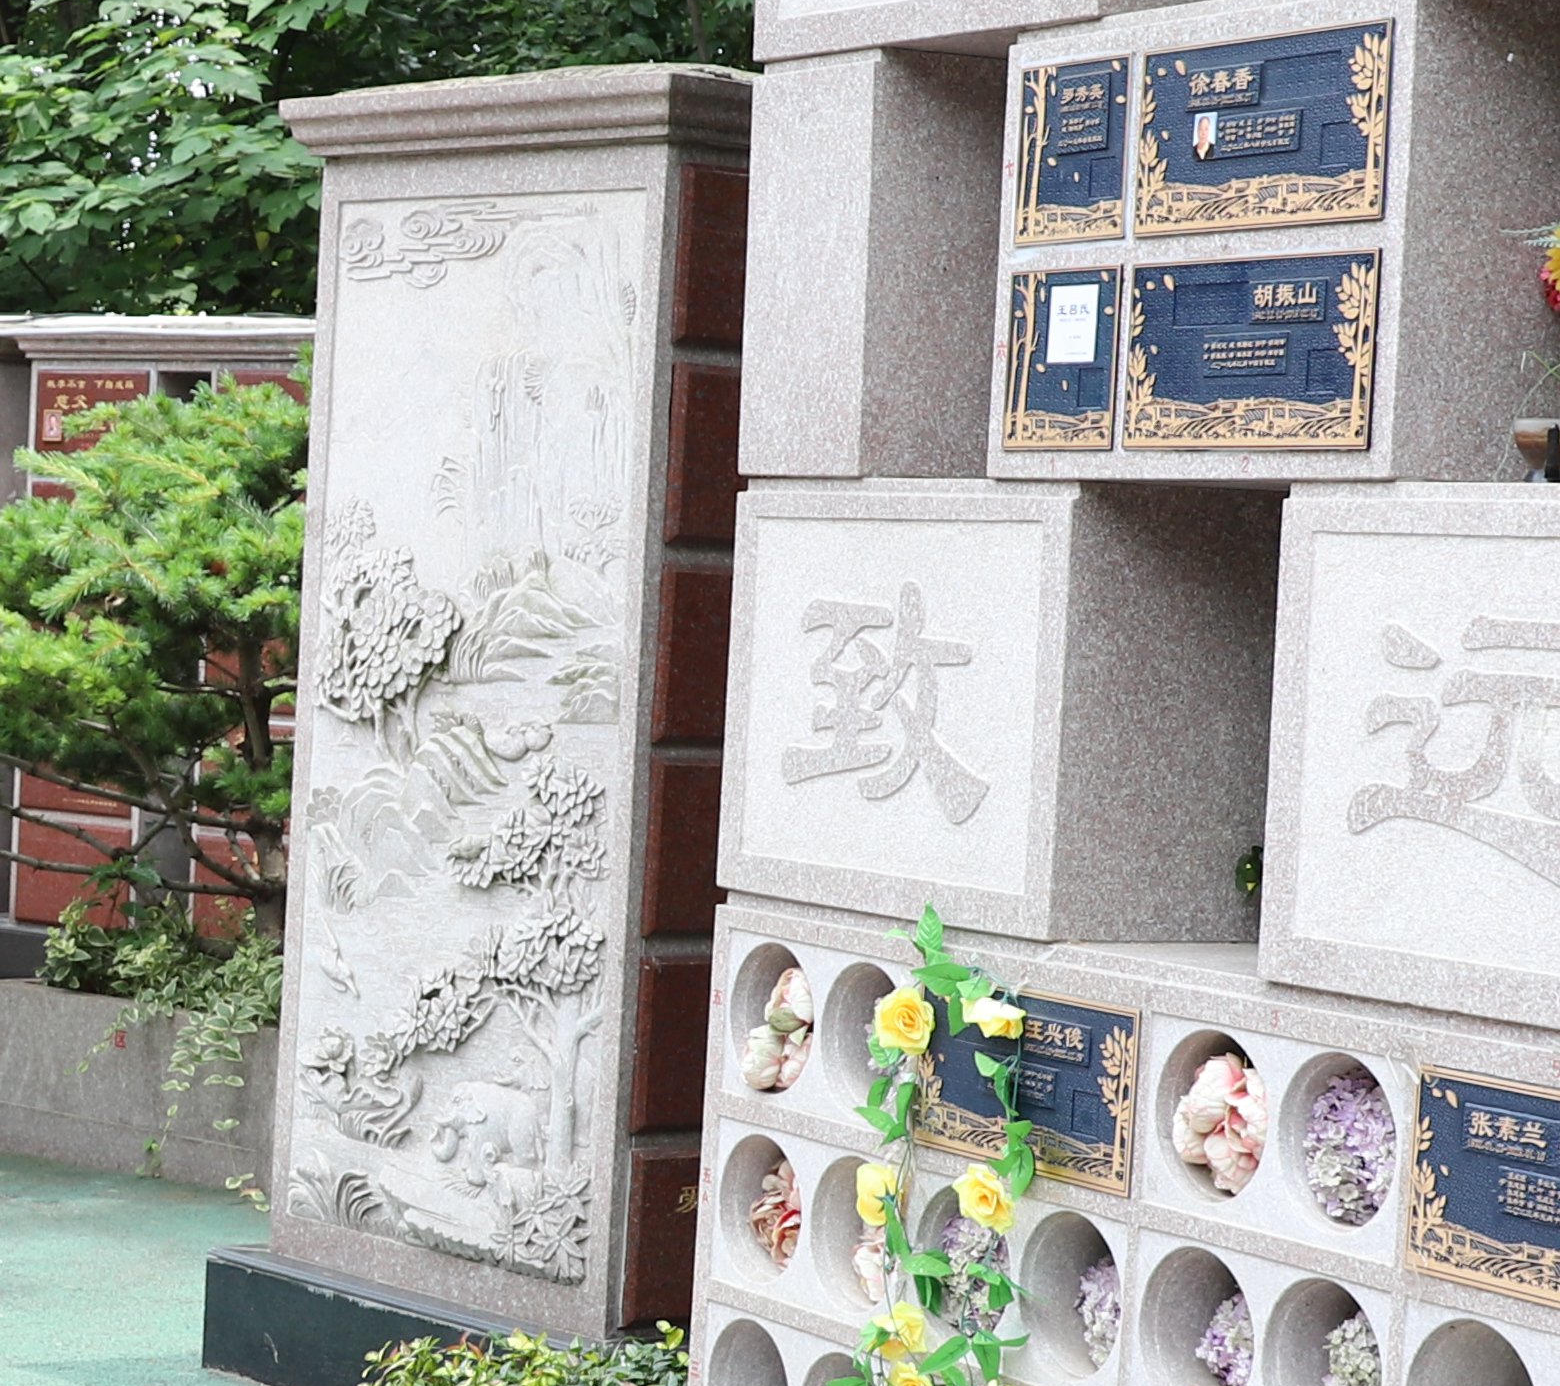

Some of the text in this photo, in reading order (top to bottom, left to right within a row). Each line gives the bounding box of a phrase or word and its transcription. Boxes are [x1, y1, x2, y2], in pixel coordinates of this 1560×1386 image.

[1188, 69, 1256, 96] 徐春香
[1253, 281, 1318, 308] 胡振山
[781, 580, 990, 825] 致
[1467, 1110, 1548, 1149] 张素兰
